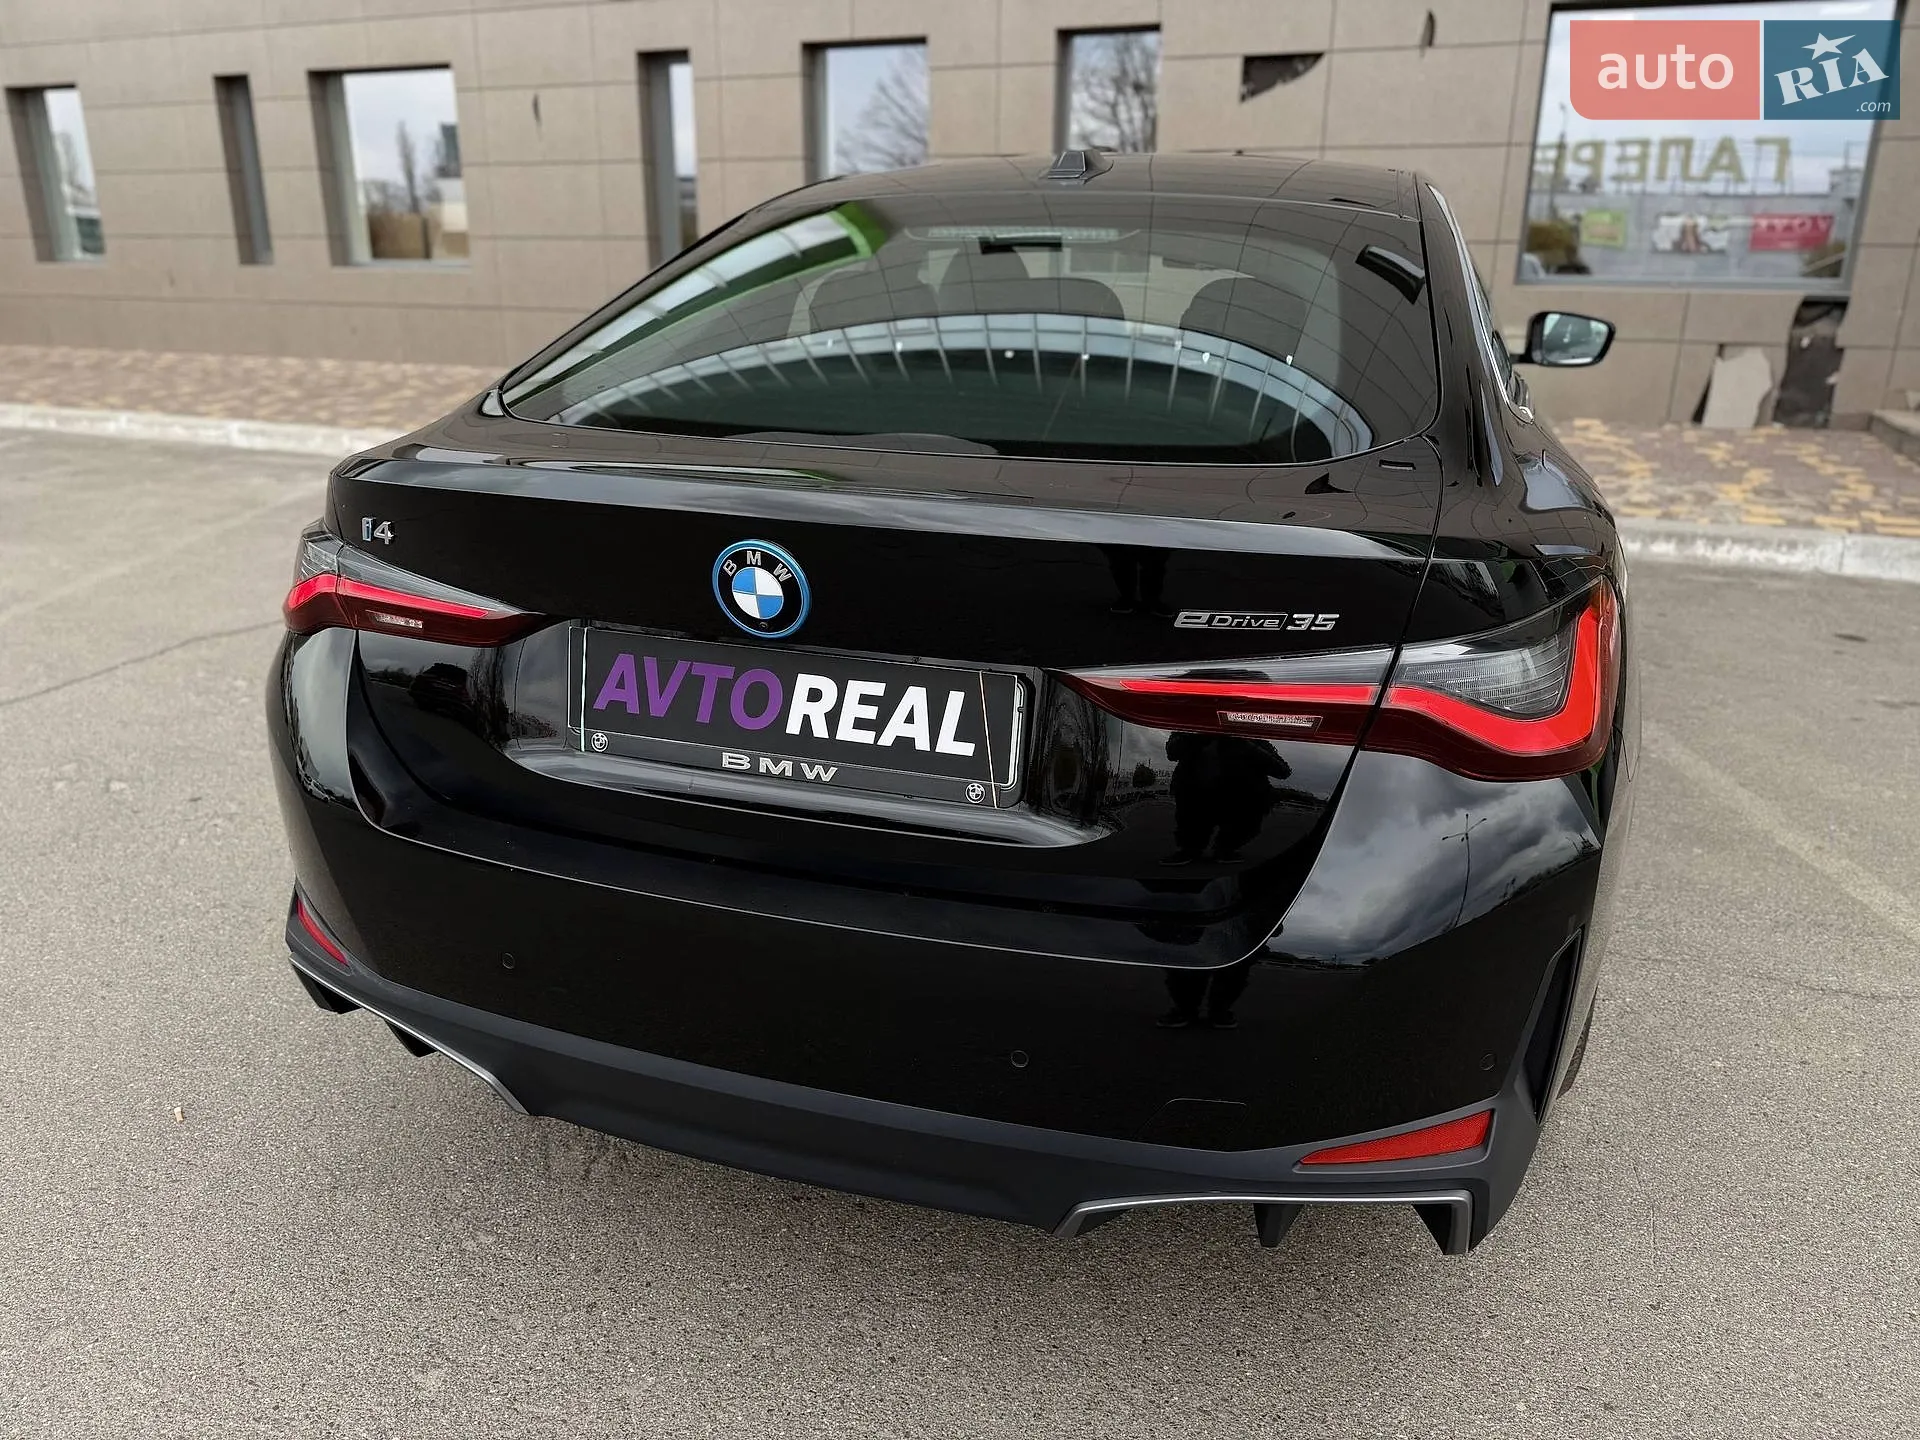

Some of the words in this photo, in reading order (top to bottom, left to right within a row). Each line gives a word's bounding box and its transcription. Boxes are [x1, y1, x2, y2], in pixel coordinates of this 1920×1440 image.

[362, 517, 394, 544] i4
[722, 550, 792, 582] BMW
[1286, 614, 1340, 631] 35
[593, 652, 976, 757] AVTOREAL
[721, 751, 838, 782] BMW
